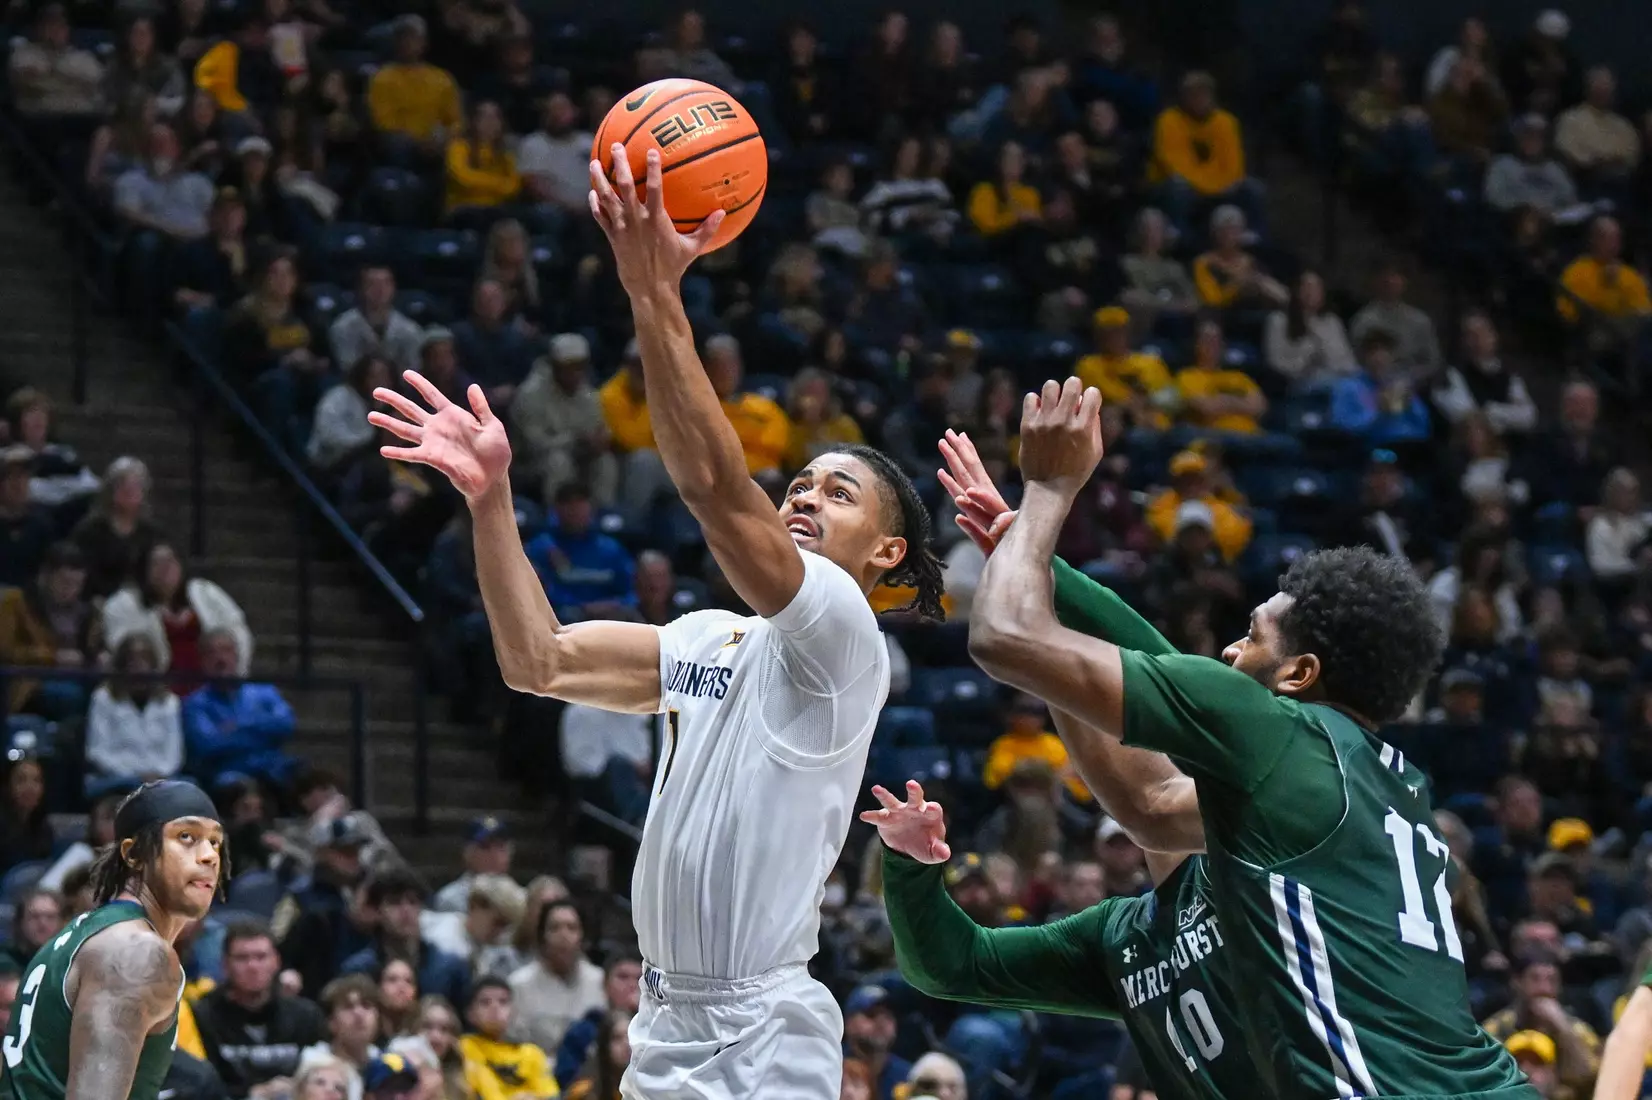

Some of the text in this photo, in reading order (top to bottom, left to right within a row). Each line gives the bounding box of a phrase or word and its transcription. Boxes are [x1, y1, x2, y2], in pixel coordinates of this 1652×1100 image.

[650, 100, 738, 149] ELITE
[1120, 914, 1224, 1009] MERCURST
[2, 963, 47, 1069] 3
